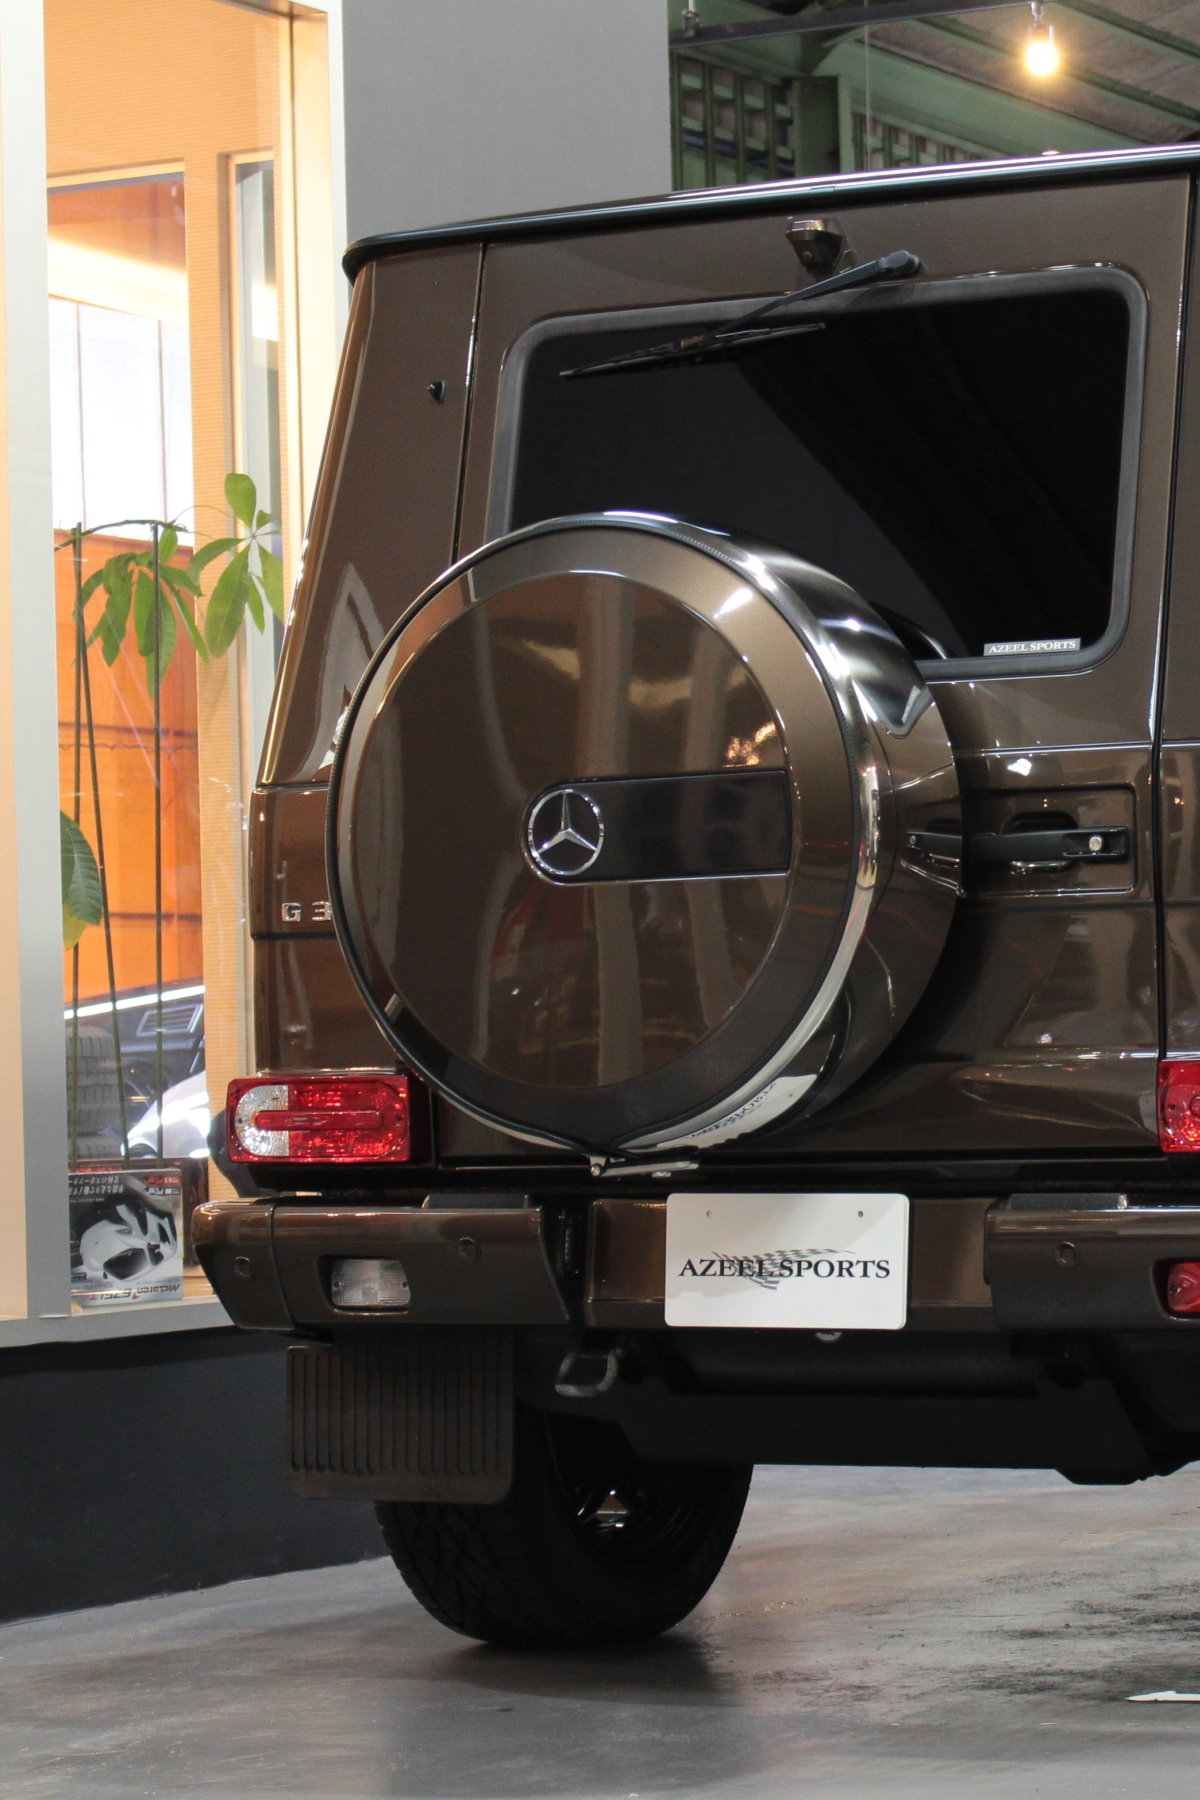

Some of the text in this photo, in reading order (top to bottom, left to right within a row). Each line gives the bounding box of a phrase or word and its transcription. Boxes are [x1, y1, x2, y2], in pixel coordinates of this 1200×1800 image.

[988, 640, 1076, 654] AZEEL SPORTS
[281, 902, 301, 922] G
[678, 1258, 891, 1278] AZEEL SPORTS
